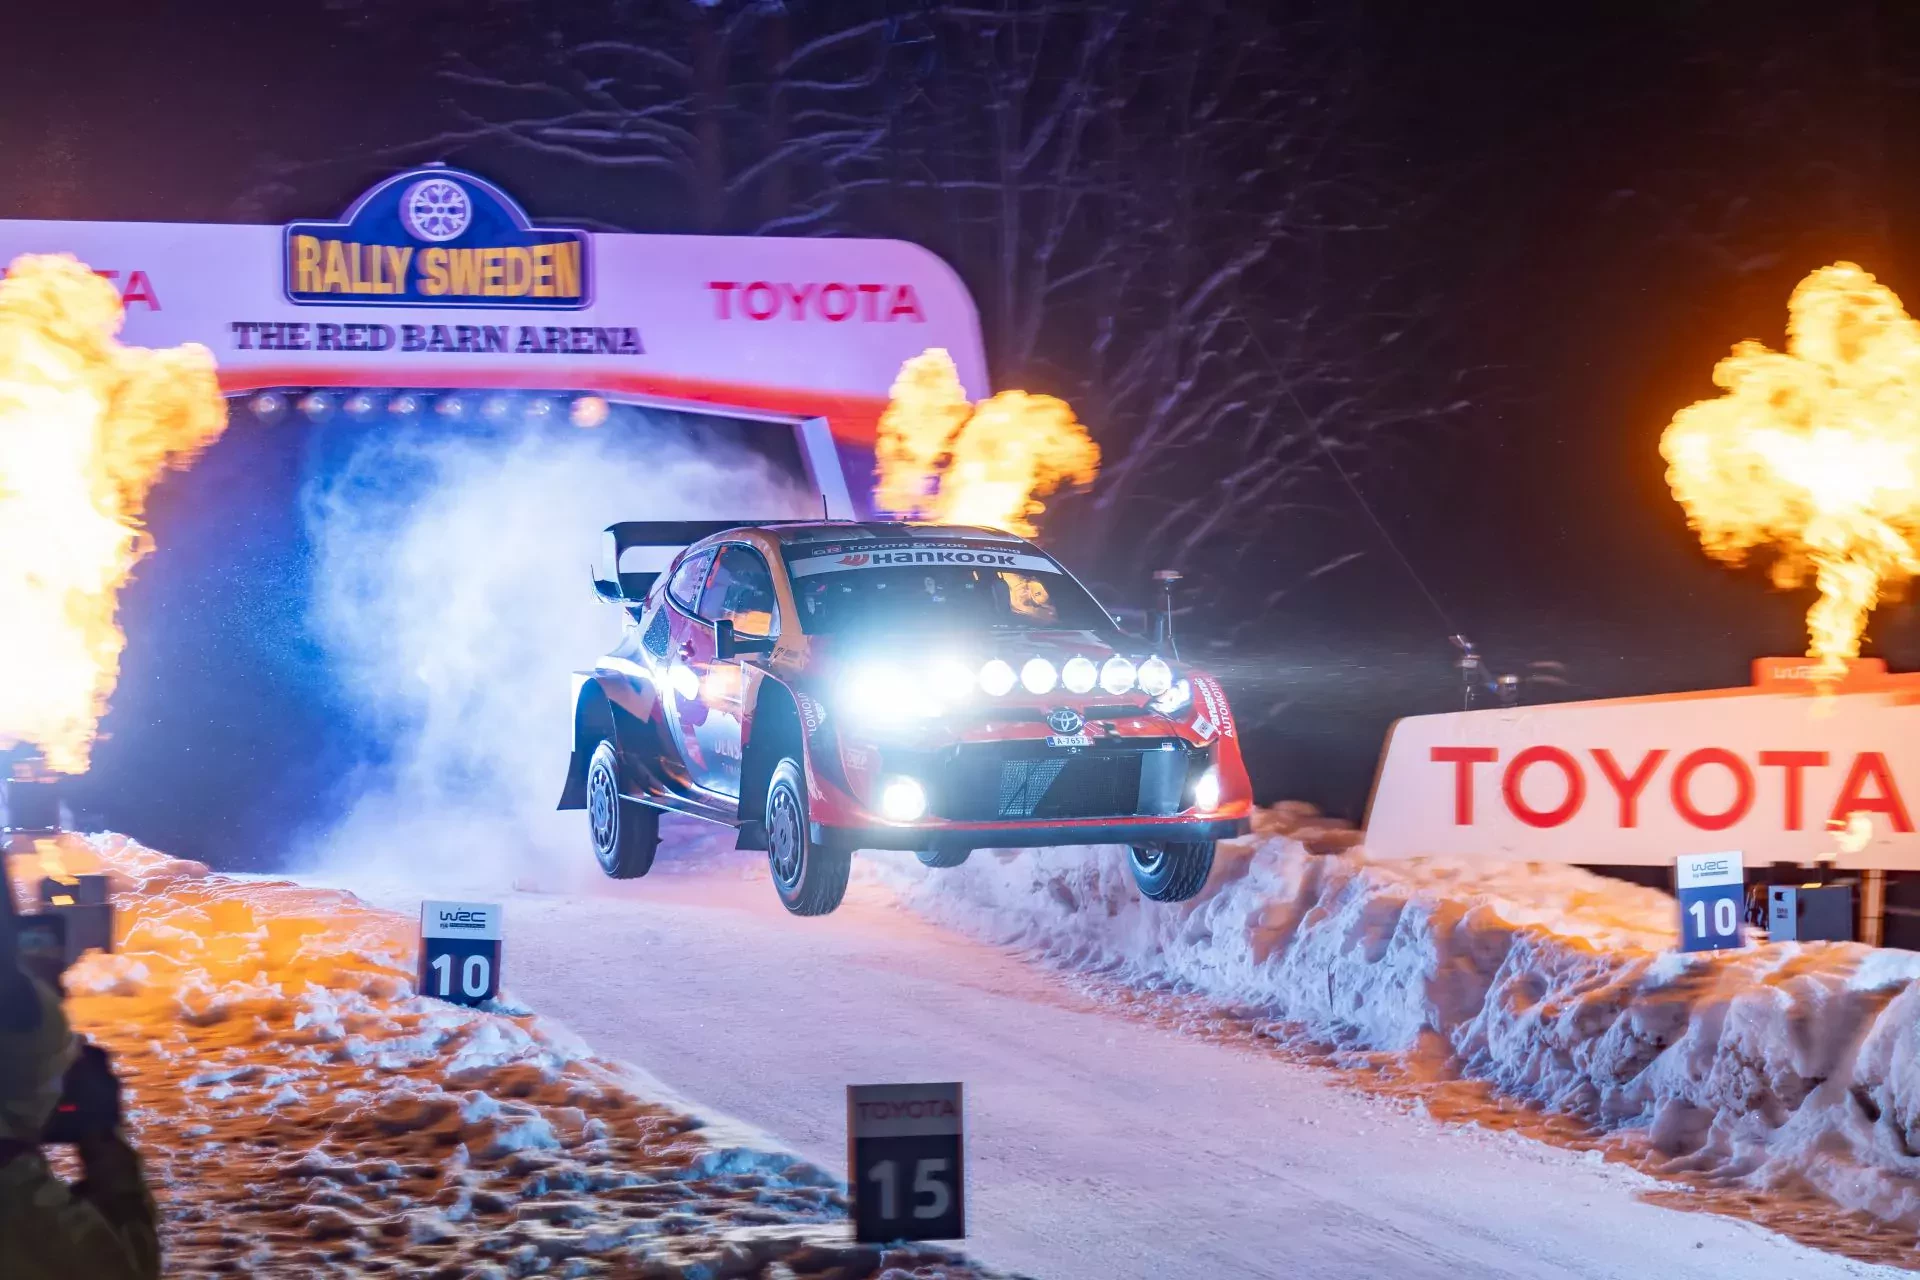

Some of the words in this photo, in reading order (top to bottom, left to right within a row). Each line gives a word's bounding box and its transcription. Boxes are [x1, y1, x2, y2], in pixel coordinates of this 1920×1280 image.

[290, 234, 413, 294] RALLY
[419, 241, 581, 297] SWEDEN
[705, 281, 928, 323] TOYOTA
[231, 321, 311, 351] THE
[316, 323, 397, 352] RED
[401, 324, 509, 354] BARN
[514, 325, 646, 355] ARENA
[846, 543, 909, 552] TOYOTA
[1429, 745, 1917, 833] TOYOTA
[1691, 860, 1729, 872] WRC
[439, 910, 487, 922] WRC
[1689, 898, 1737, 938] 10
[432, 954, 490, 998] 10
[857, 1100, 960, 1121] TOYOTA
[868, 1158, 952, 1219] 15
